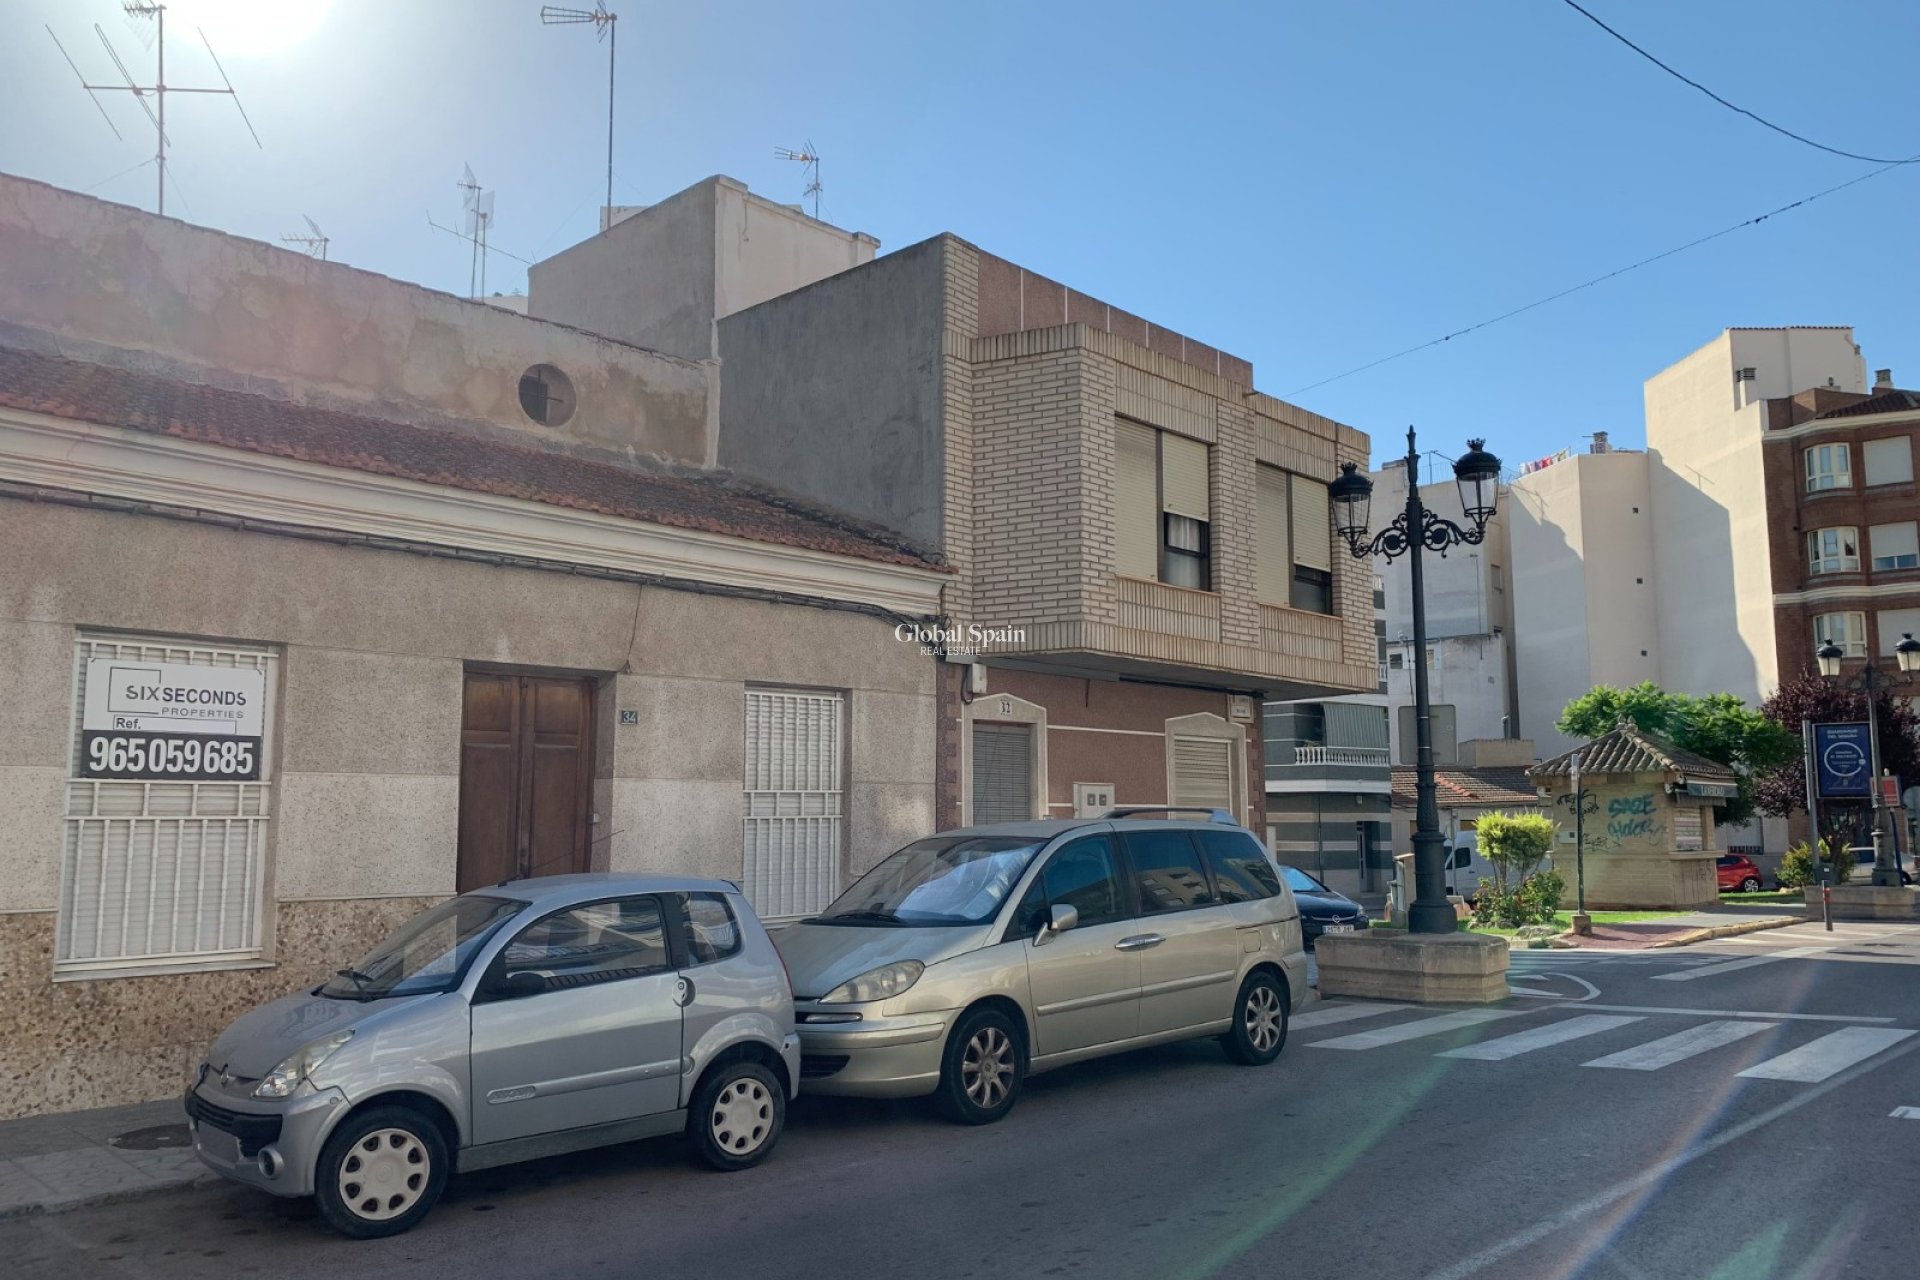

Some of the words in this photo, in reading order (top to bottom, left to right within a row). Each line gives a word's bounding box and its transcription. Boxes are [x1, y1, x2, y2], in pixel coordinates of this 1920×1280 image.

[161, 706, 244, 719] PROPERTIES
[623, 711, 636, 723] 34
[115, 717, 142, 730] Ref.
